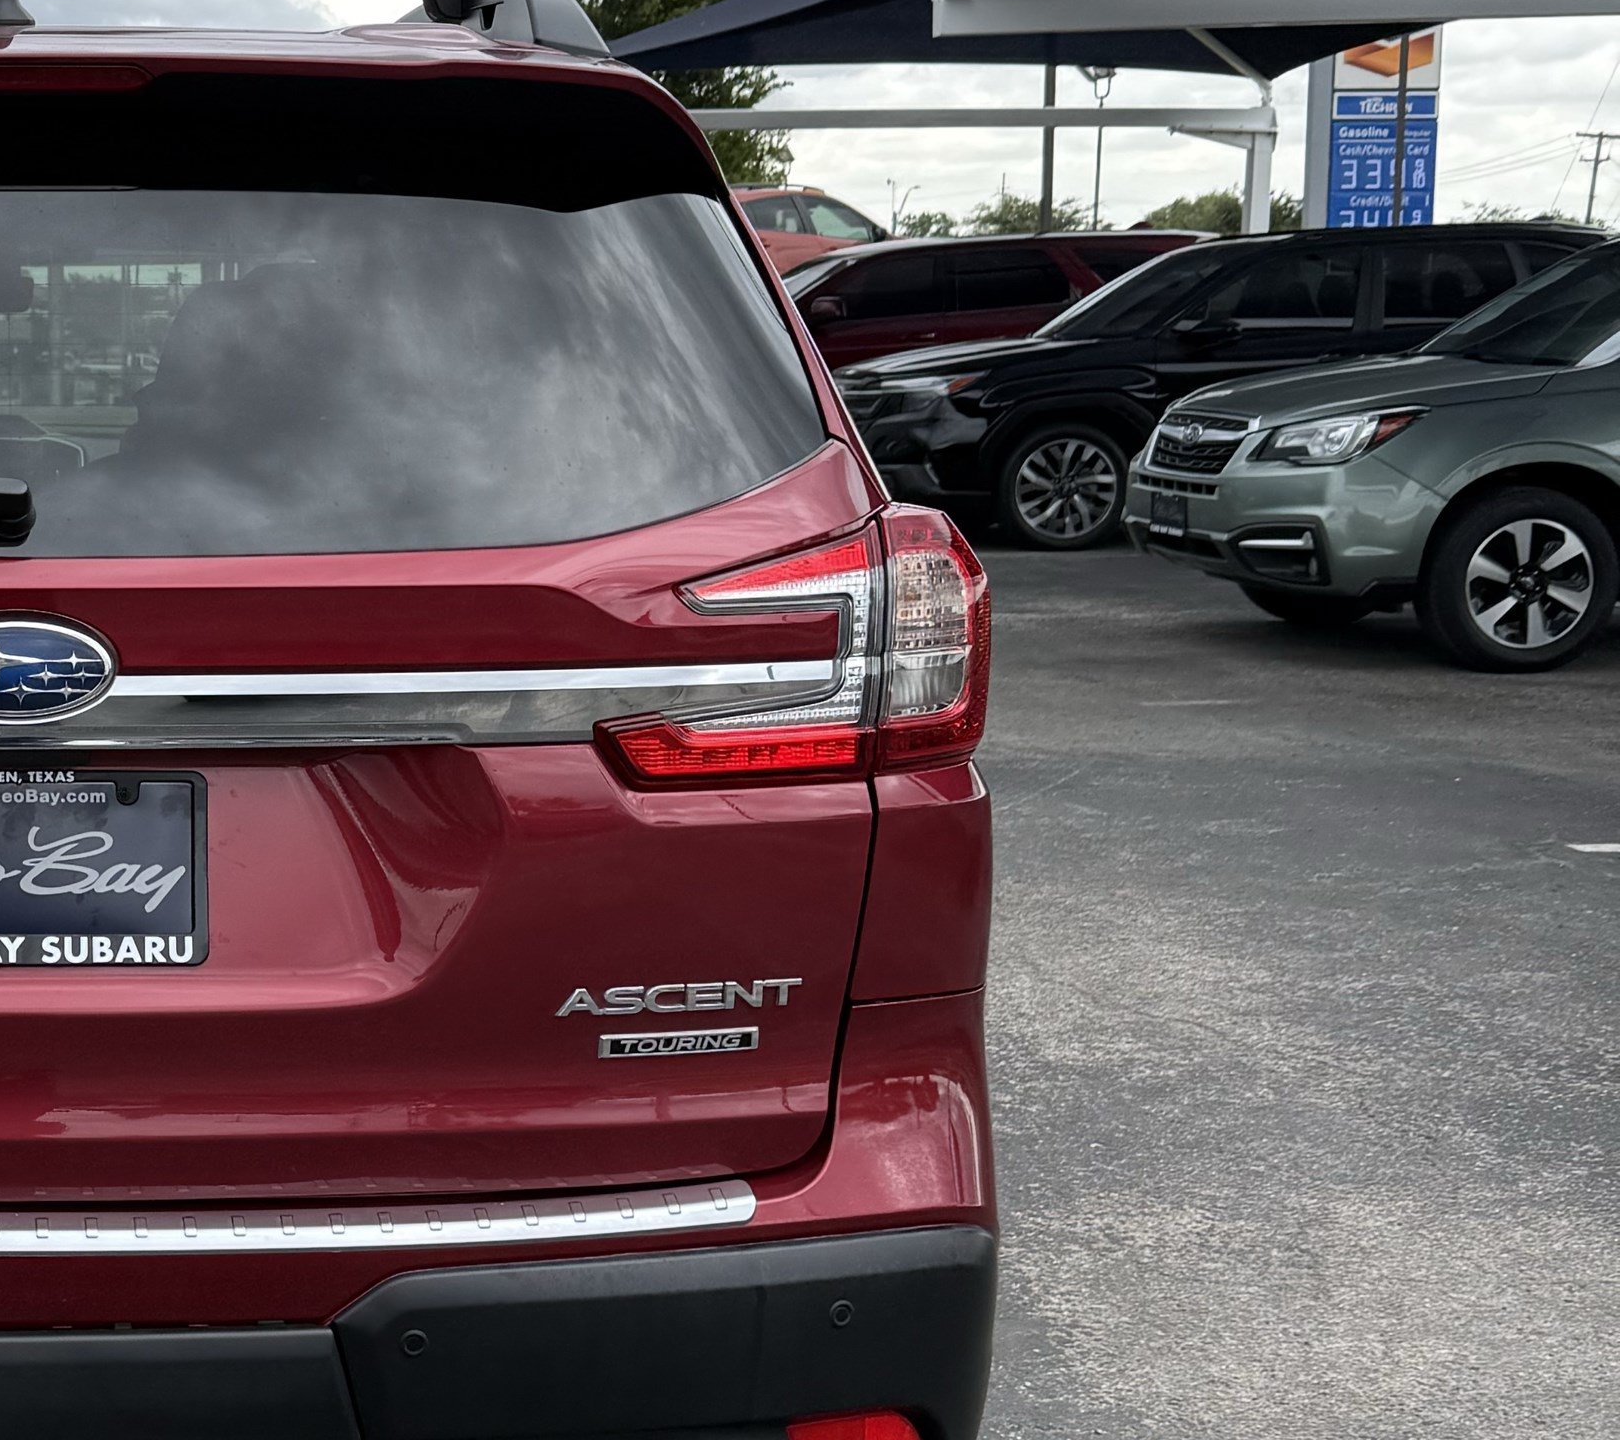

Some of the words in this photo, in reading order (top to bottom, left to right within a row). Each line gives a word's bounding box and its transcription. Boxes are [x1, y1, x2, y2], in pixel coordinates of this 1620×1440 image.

[1360, 101, 1413, 113] TECHRN
[1339, 126, 1389, 138] Gasoline
[1406, 144, 1430, 155] Card
[28, 771, 75, 784] TEXAS
[19, 826, 186, 913] Bay
[41, 936, 193, 964] SUBARU
[554, 977, 803, 1017] ASCENT
[620, 1033, 743, 1054] TOURING
